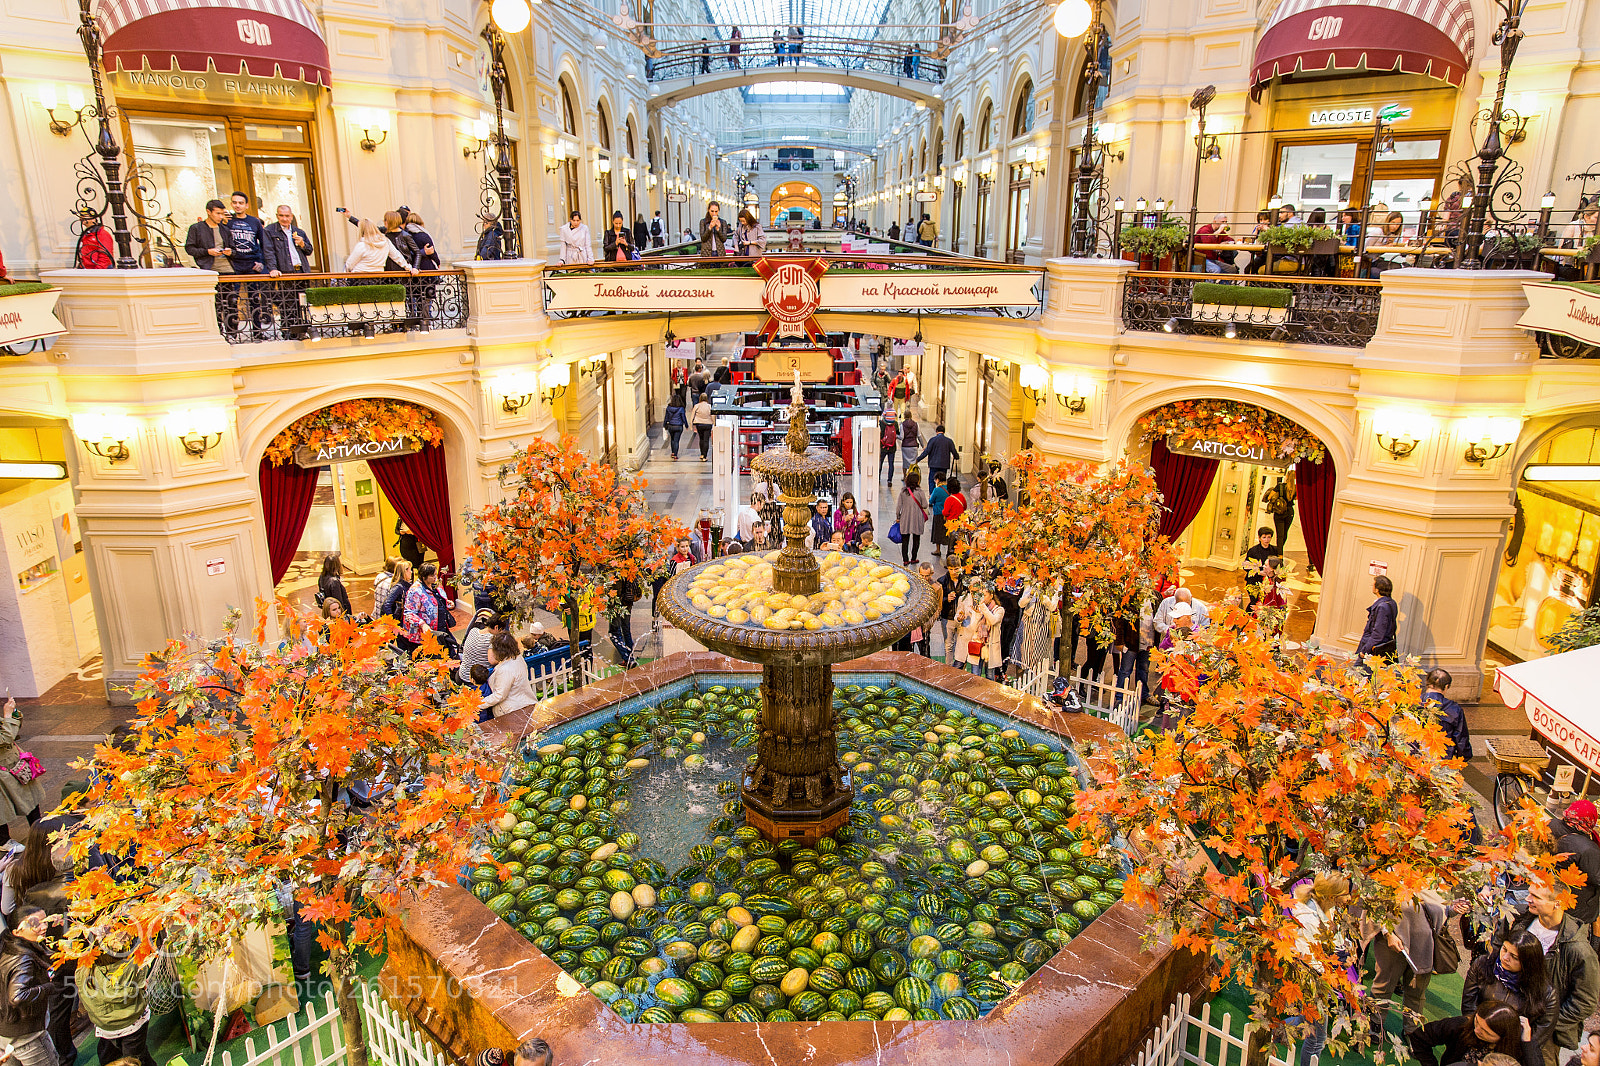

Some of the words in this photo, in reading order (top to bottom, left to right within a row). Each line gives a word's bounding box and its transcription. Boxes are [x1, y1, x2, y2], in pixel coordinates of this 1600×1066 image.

[130, 71, 208, 91] MANOLO
[224, 79, 297, 98] BLAHNIK
[1310, 109, 1373, 124] LACOSTE
[779, 266, 804, 286] ГУМ
[593, 282, 650, 298] Главный
[655, 288, 716, 299] магазин
[861, 286, 879, 297] на
[882, 281, 941, 300] Красной
[942, 285, 1000, 299] площади
[782, 324, 801, 332] GUM
[791, 358, 797, 368] 2
[316, 438, 403, 460] АРТИКОЛИ
[1191, 440, 1264, 460] ARTICOLI
[1533, 706, 1568, 742] BOSCO
